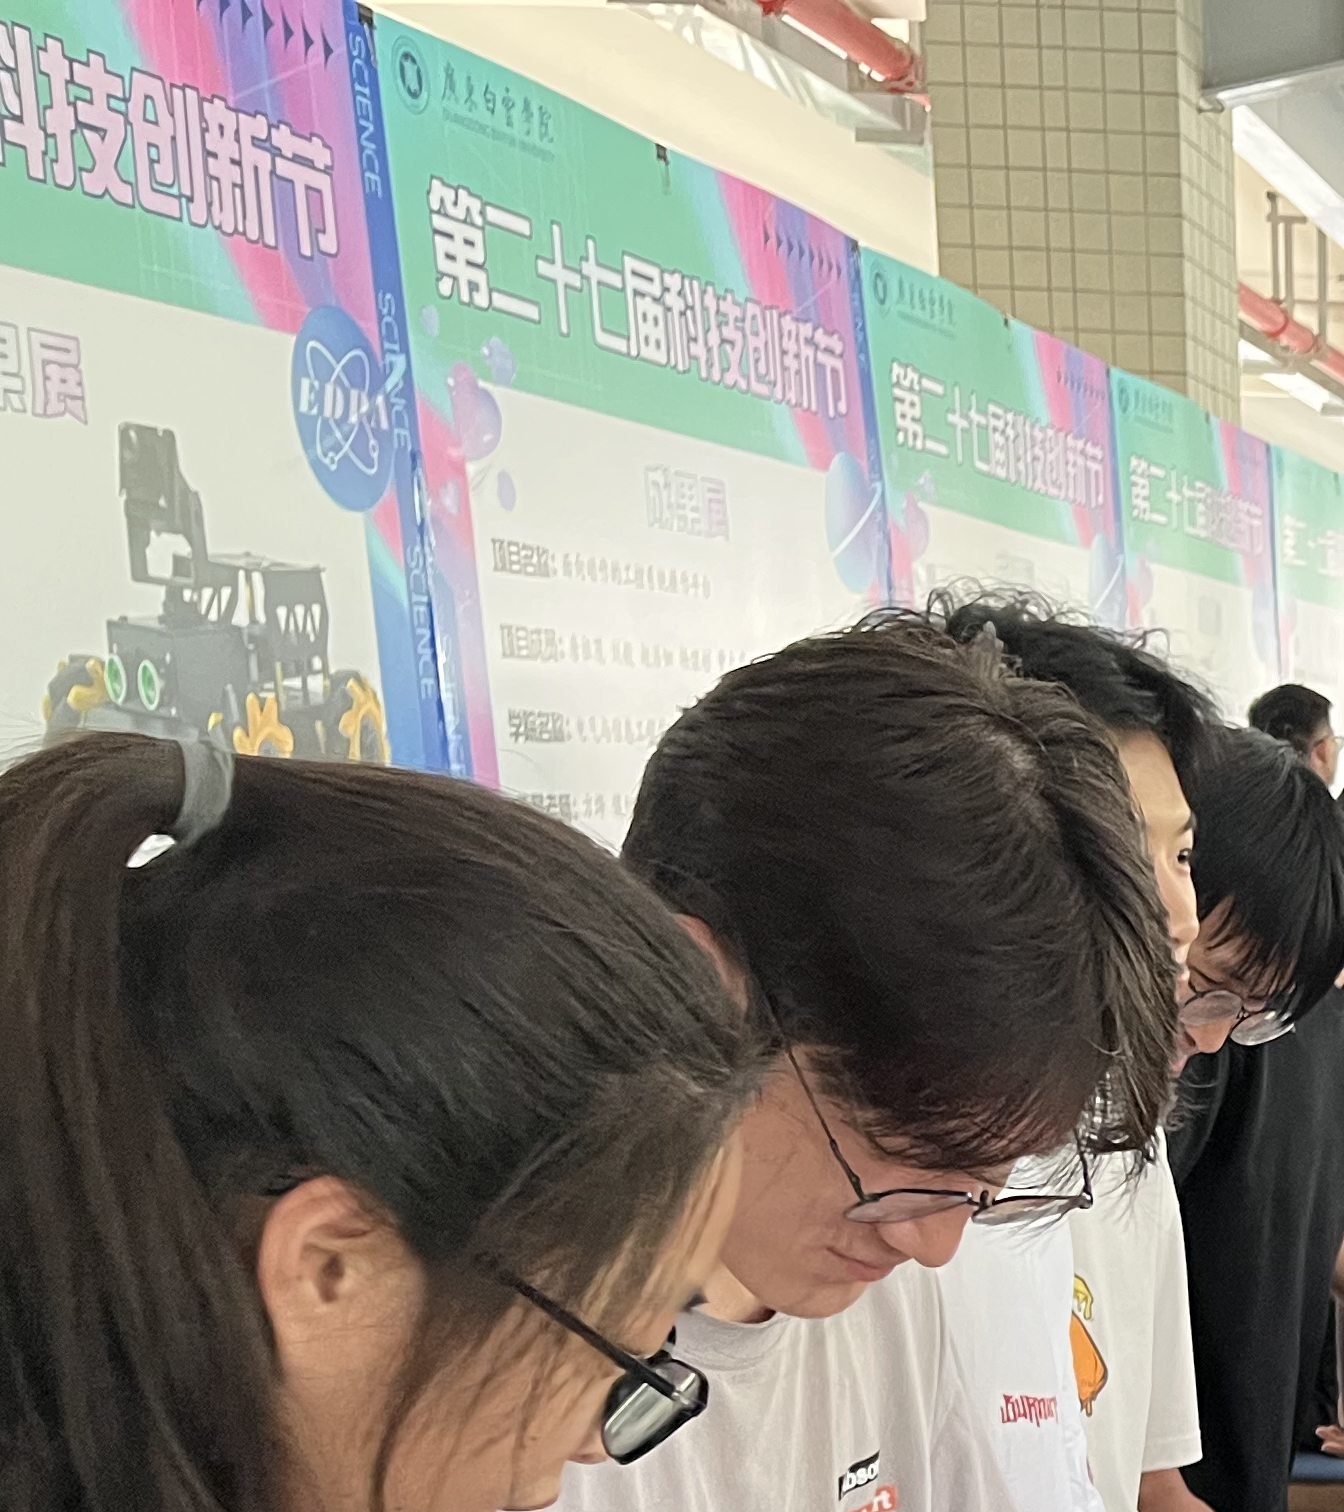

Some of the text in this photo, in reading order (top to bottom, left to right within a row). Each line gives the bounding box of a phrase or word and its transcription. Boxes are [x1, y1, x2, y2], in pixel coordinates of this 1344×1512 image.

[348, 31, 383, 200] SCIENCE
[378, 288, 412, 452] SCIENCE
[429, 174, 850, 419] 第二十七届科技创新节
[890, 356, 1105, 510] 第二十七届科技创新节
